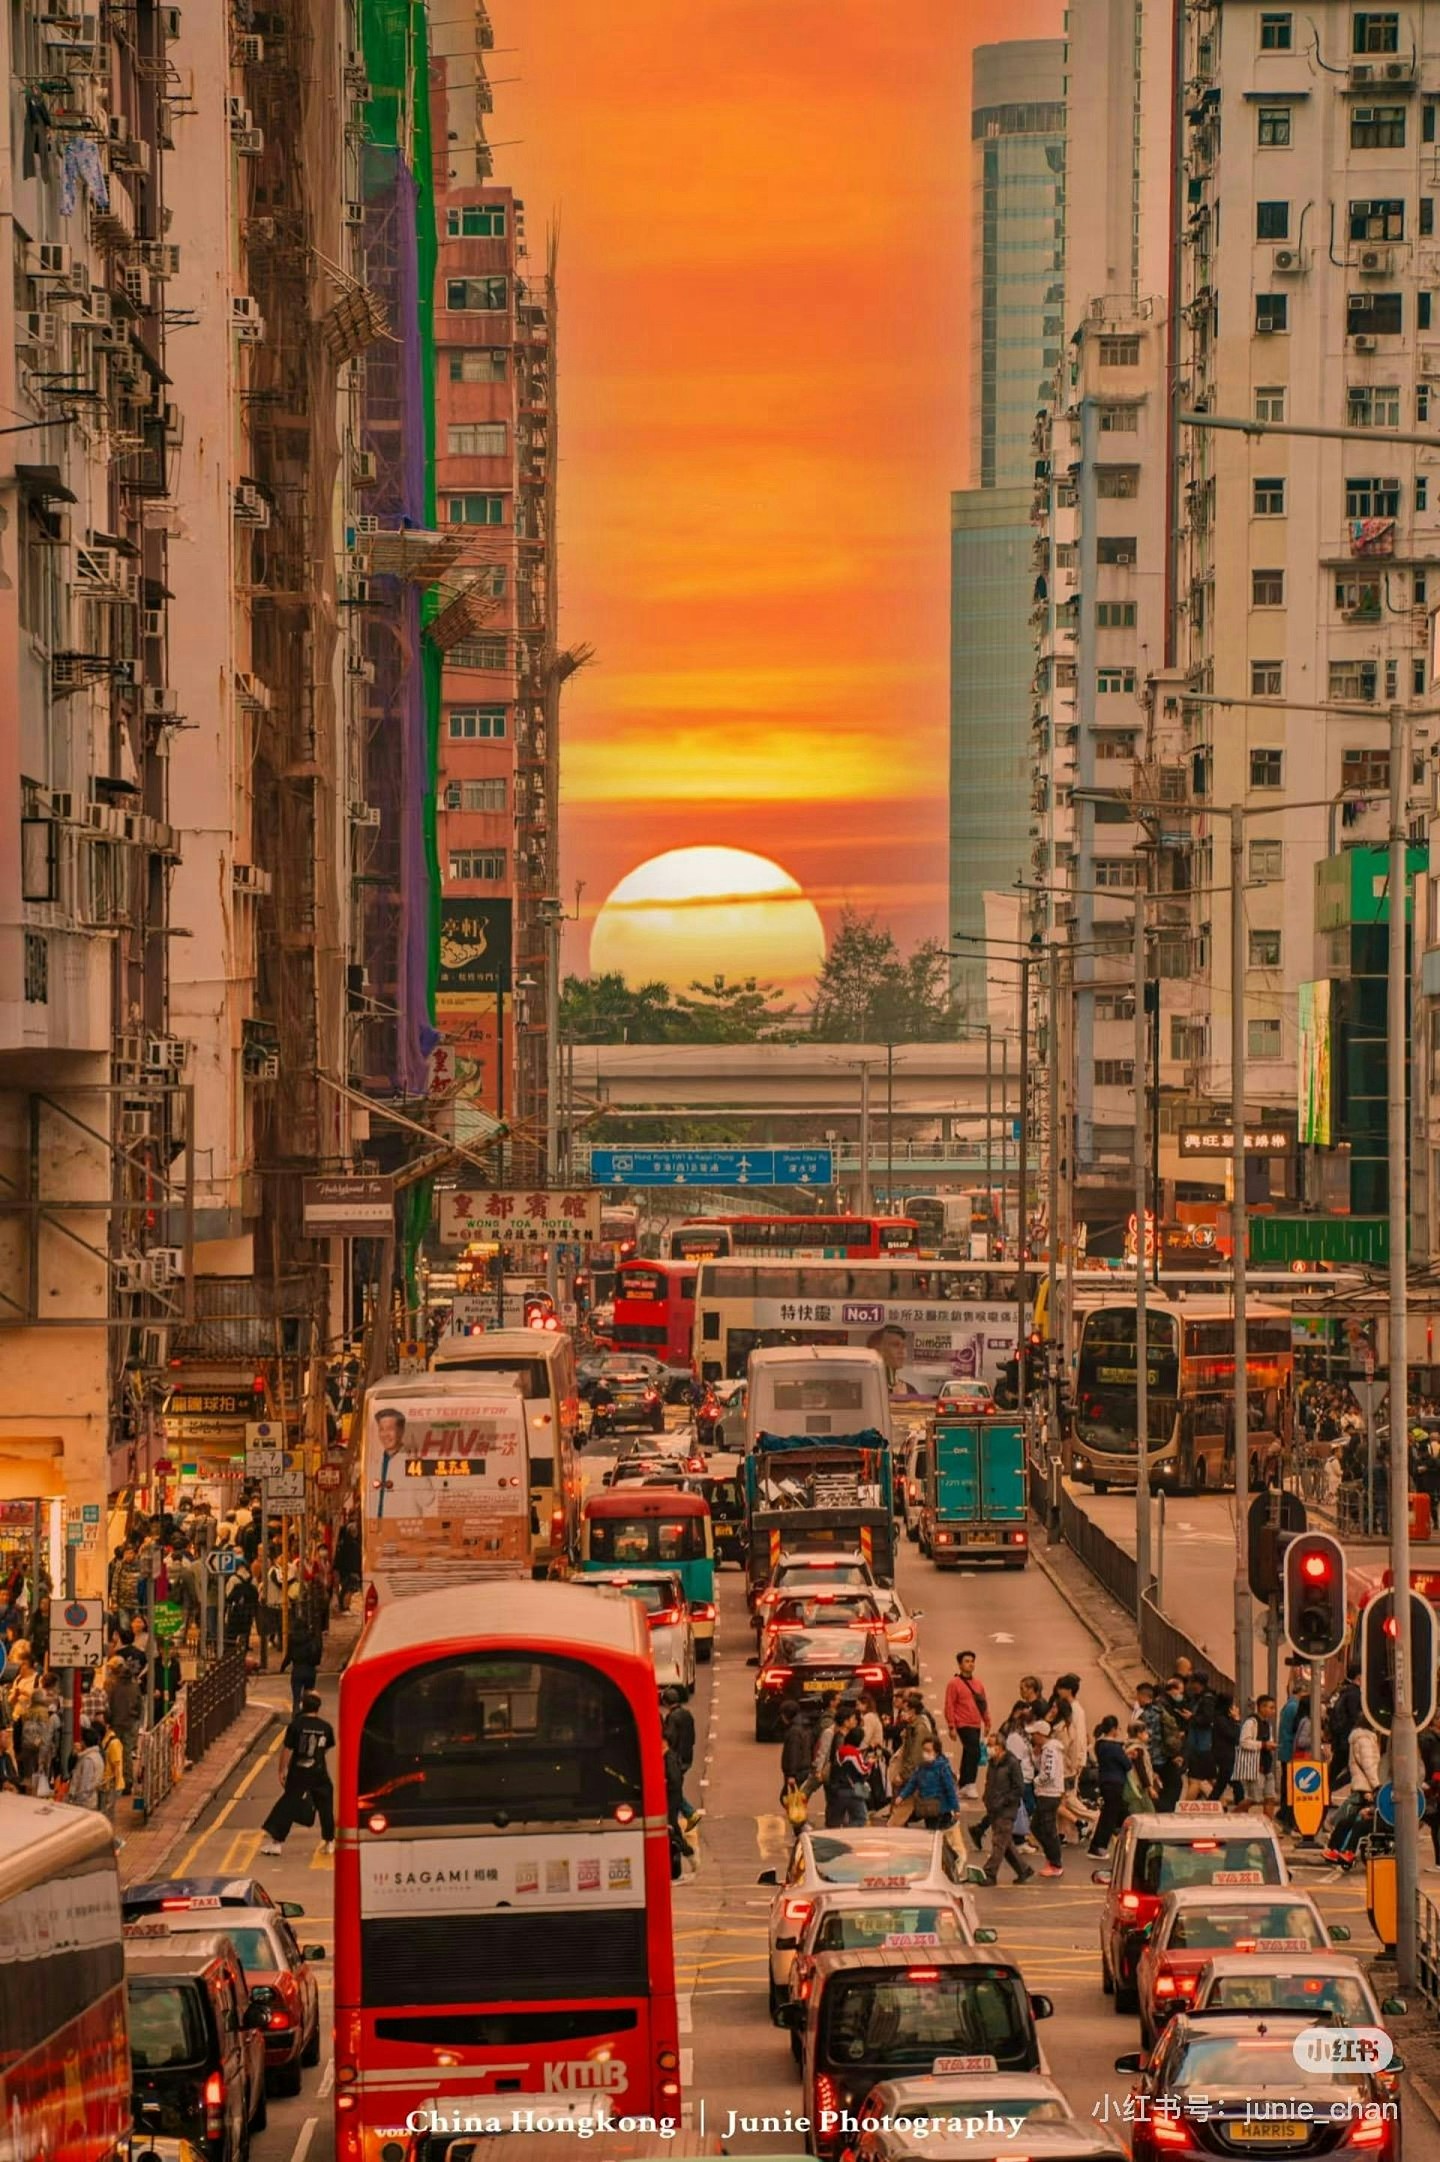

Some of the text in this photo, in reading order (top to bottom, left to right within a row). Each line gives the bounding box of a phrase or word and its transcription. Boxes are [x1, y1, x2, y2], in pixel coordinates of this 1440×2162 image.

[453, 1193, 588, 1219] 皇都賓館
[467, 1220, 574, 1228] WONG TOA HOTEL
[781, 1305, 831, 1321] 特快靈
[847, 1308, 879, 1321] No.1
[421, 1429, 479, 1457] HIV
[407, 1461, 422, 1476] 44
[83, 1633, 91, 1645] 7
[83, 1653, 99, 1665] 12
[1178, 1802, 1220, 1812] TAXI
[394, 1869, 468, 1885] SAGAMI
[864, 1877, 906, 1887] TAXI
[1216, 1873, 1261, 1883] TAXI
[192, 1898, 219, 1907] TAXI
[123, 1924, 165, 1936] TAXI
[889, 1935, 935, 1945] TAXI
[1259, 1939, 1307, 1949] TAXI
[938, 2058, 991, 2071] TAXI
[543, 2060, 629, 2093] KMB
[1242, 2123, 1295, 2138] HARRIS
